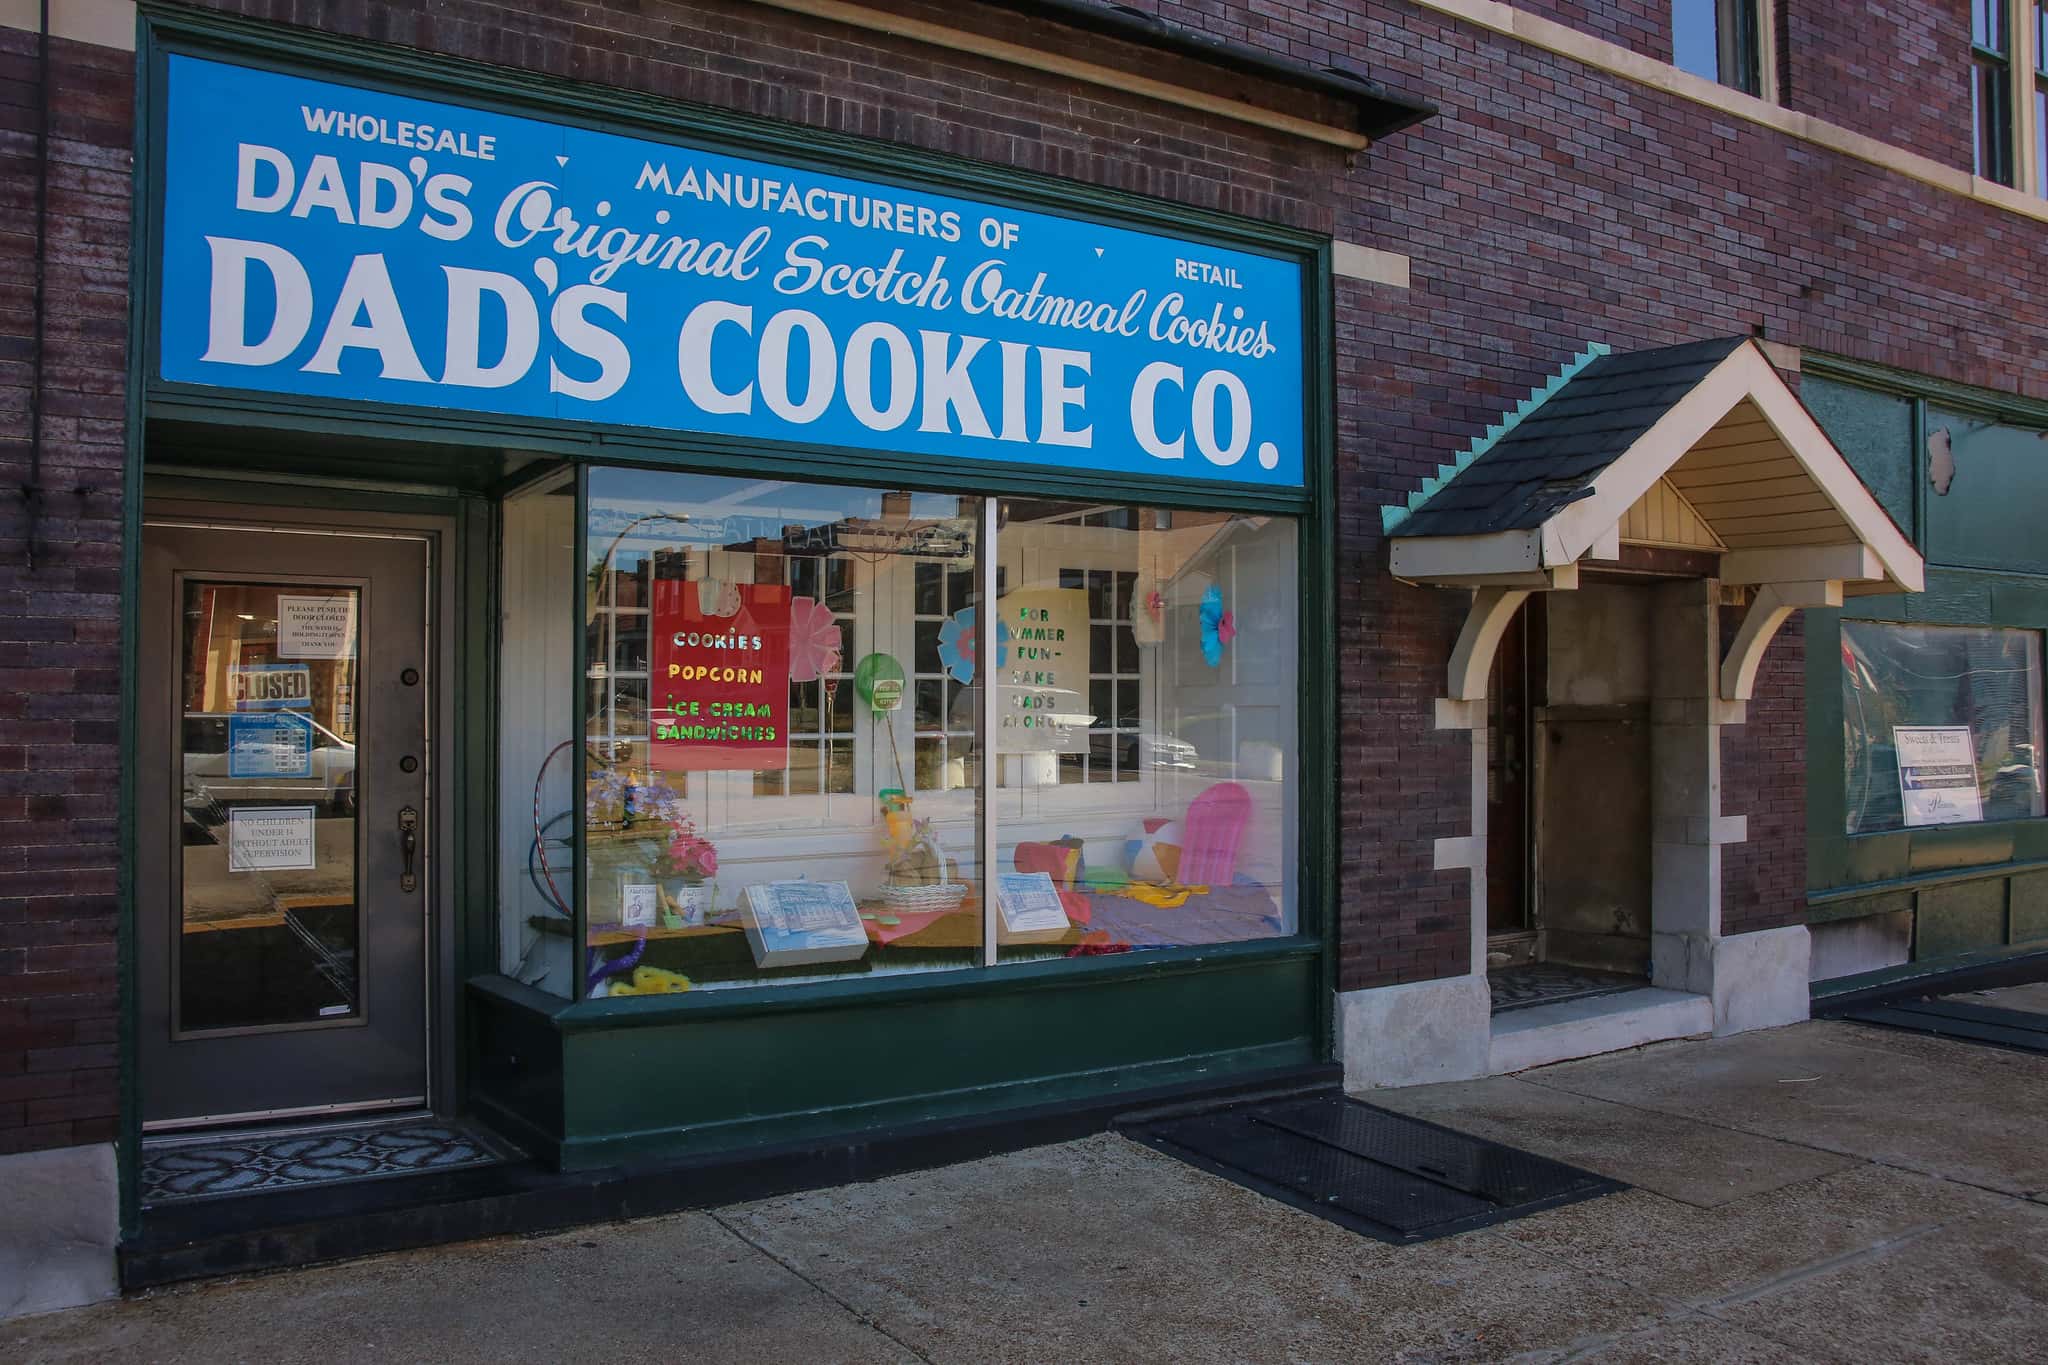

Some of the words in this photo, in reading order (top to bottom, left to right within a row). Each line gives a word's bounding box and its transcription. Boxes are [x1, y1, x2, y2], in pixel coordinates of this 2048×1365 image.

[300, 105, 498, 162] WHOLESALE
[634, 161, 962, 243] MANUFACTURERS
[979, 217, 1021, 251] OF
[235, 142, 474, 242] DAD'S
[493, 180, 773, 287] Original
[772, 234, 954, 312] Scotch
[960, 258, 1148, 338] Oatmeal
[1147, 291, 1278, 360] Cookies
[1174, 257, 1244, 290] RETAIL
[198, 234, 633, 403] DAD'S
[677, 299, 1094, 450] COOKIE
[1129, 360, 1280, 471] CO.
[287, 605, 315, 613] PLEASE
[1020, 607, 1049, 622] FOR
[292, 614, 316, 622] DOOR
[1009, 625, 1065, 642] UMMER
[1018, 646, 1063, 660] FUN-
[668, 663, 763, 685] POPCORN
[1012, 670, 1055, 685] TAKE
[231, 671, 307, 700] CLOSED
[1012, 692, 1056, 710] DAD'S
[710, 702, 772, 718] CREAM
[1002, 714, 1064, 729] ALONG
[240, 818, 255, 826] NO
[255, 817, 305, 826] CHILDREN
[251, 829, 283, 837] UNDER
[234, 839, 279, 848] WITHOUT
[280, 838, 312, 847] ADULT
[242, 848, 303, 858] SUPERVISION
